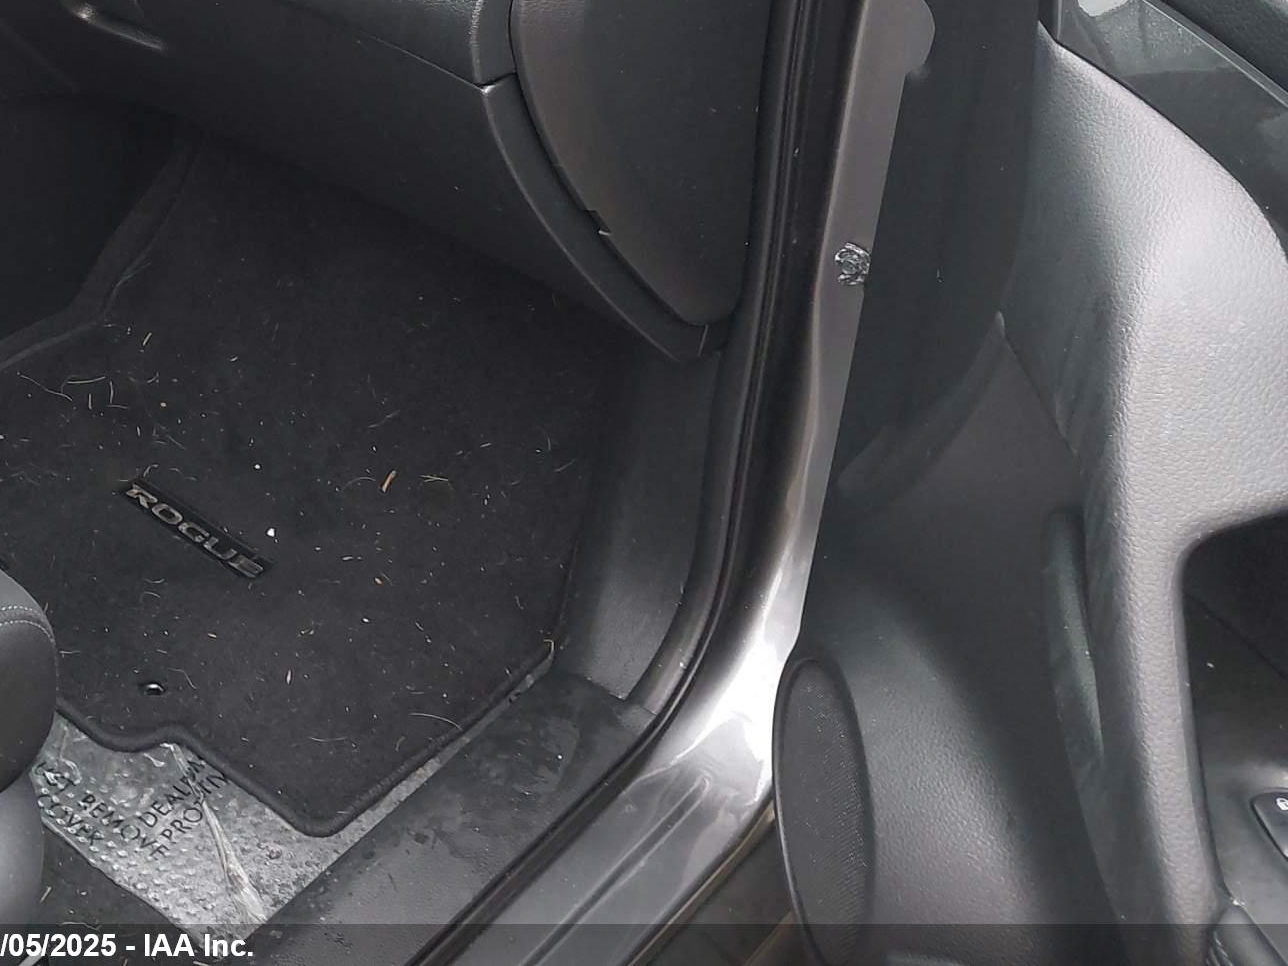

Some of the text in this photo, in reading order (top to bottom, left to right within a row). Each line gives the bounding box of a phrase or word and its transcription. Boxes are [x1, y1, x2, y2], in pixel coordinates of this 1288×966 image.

[125, 483, 265, 579] ROGUE
[37, 794, 105, 847] COVER
[77, 793, 170, 861] REMOVE
